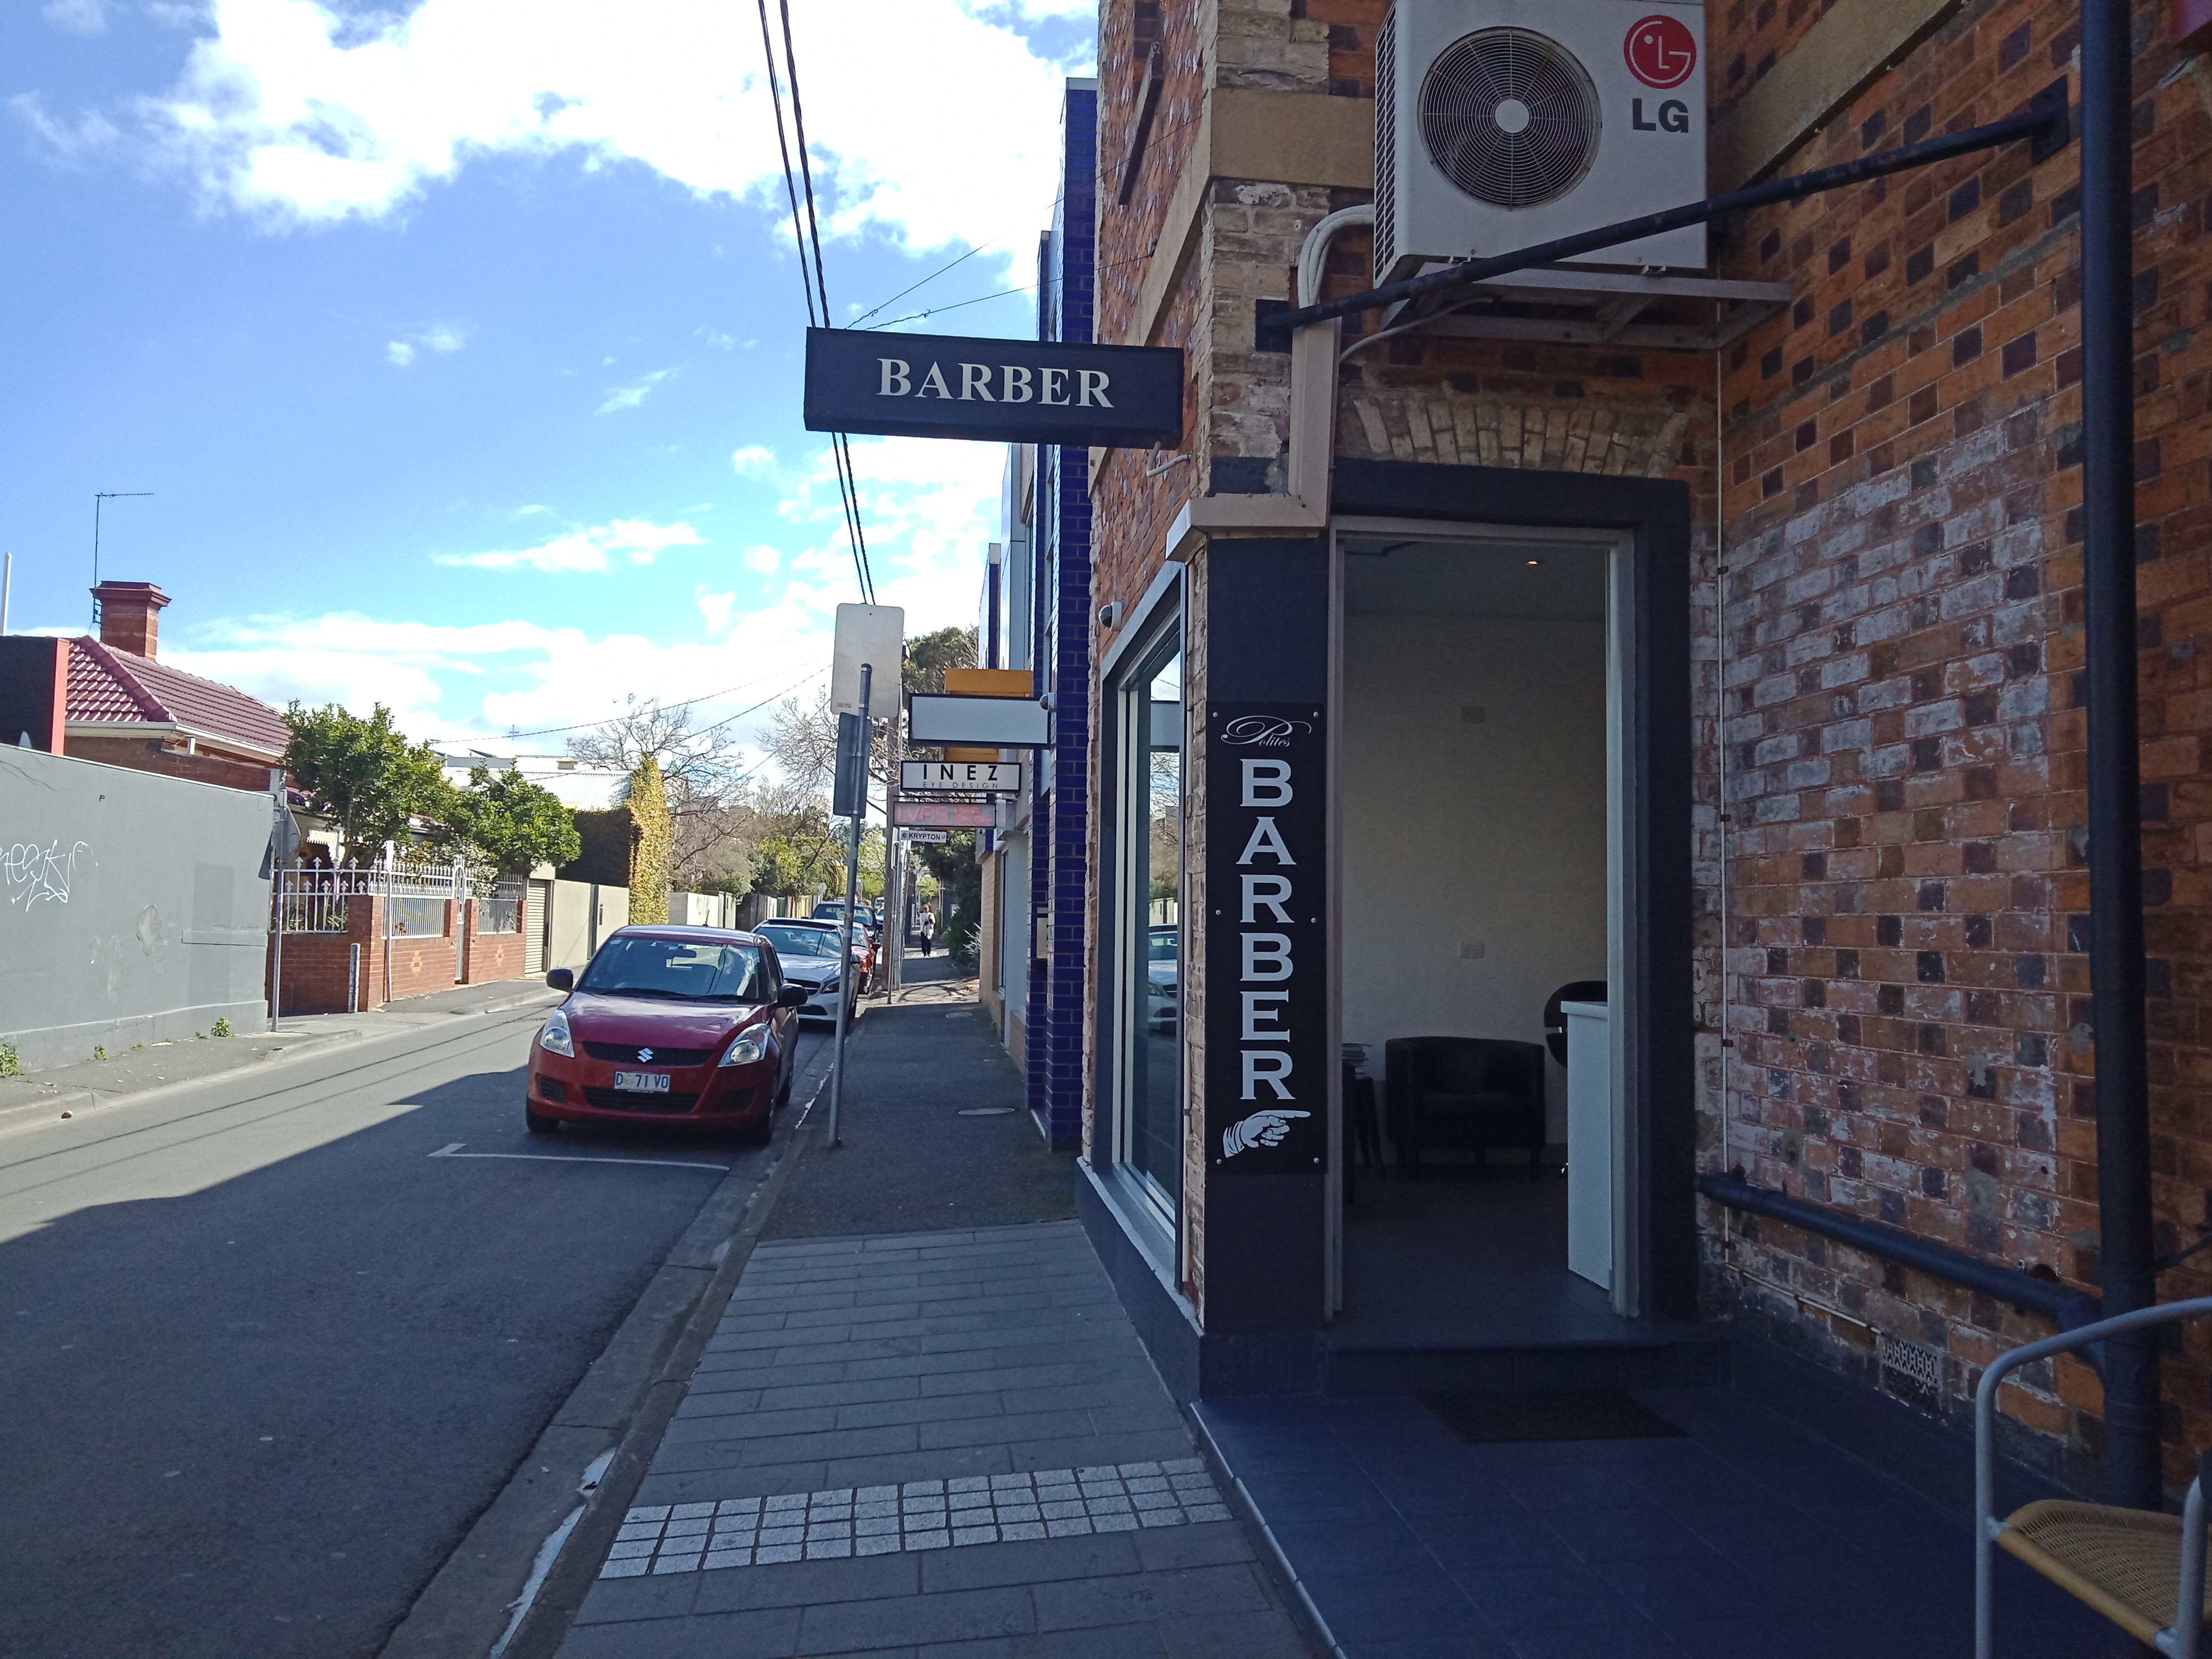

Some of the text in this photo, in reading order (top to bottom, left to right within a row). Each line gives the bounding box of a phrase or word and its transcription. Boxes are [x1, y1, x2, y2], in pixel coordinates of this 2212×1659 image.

[1632, 98, 1689, 133] LG
[876, 358, 1115, 408] BARBER
[1221, 715, 1312, 747] Polites
[923, 764, 998, 781] INEZ
[1236, 758, 1297, 1100] BARBER
